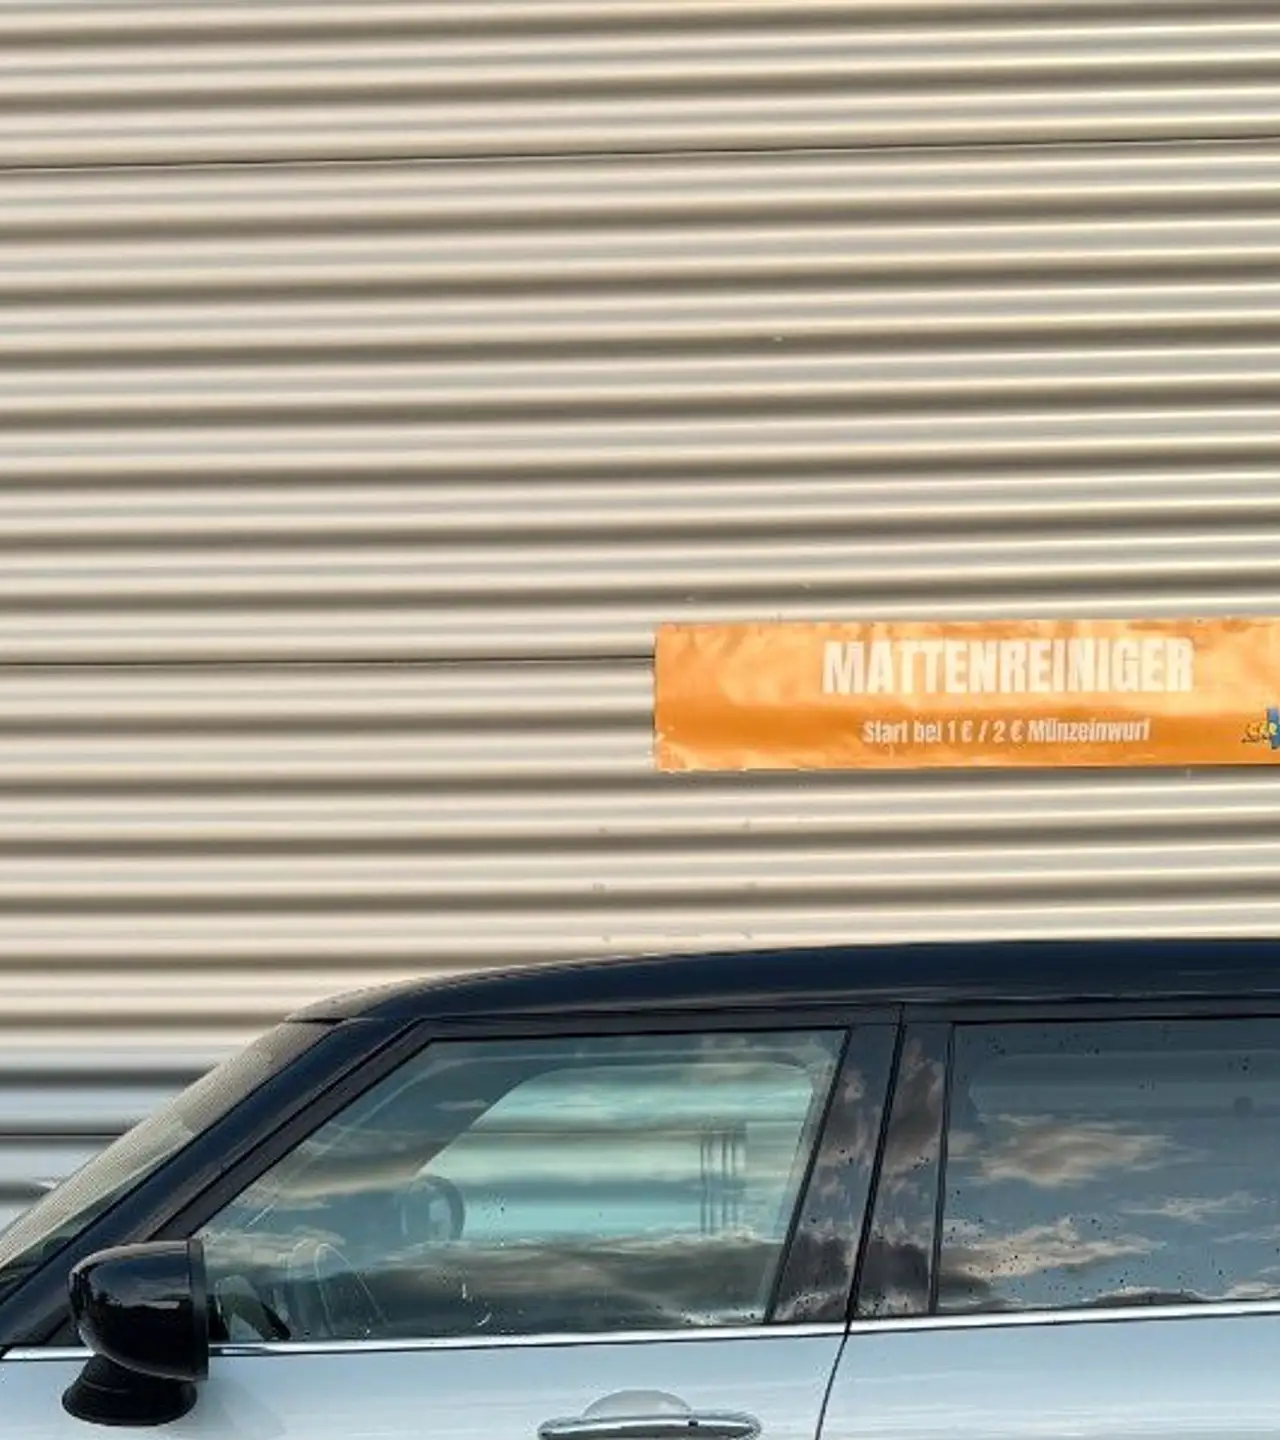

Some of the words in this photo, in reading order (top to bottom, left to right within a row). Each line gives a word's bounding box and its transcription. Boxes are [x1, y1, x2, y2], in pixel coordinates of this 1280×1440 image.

[822, 639, 1194, 693] MATTENREINIGER
[862, 721, 908, 743] Start
[913, 720, 941, 743] bei
[1027, 717, 1151, 742] Münzeinwurf
